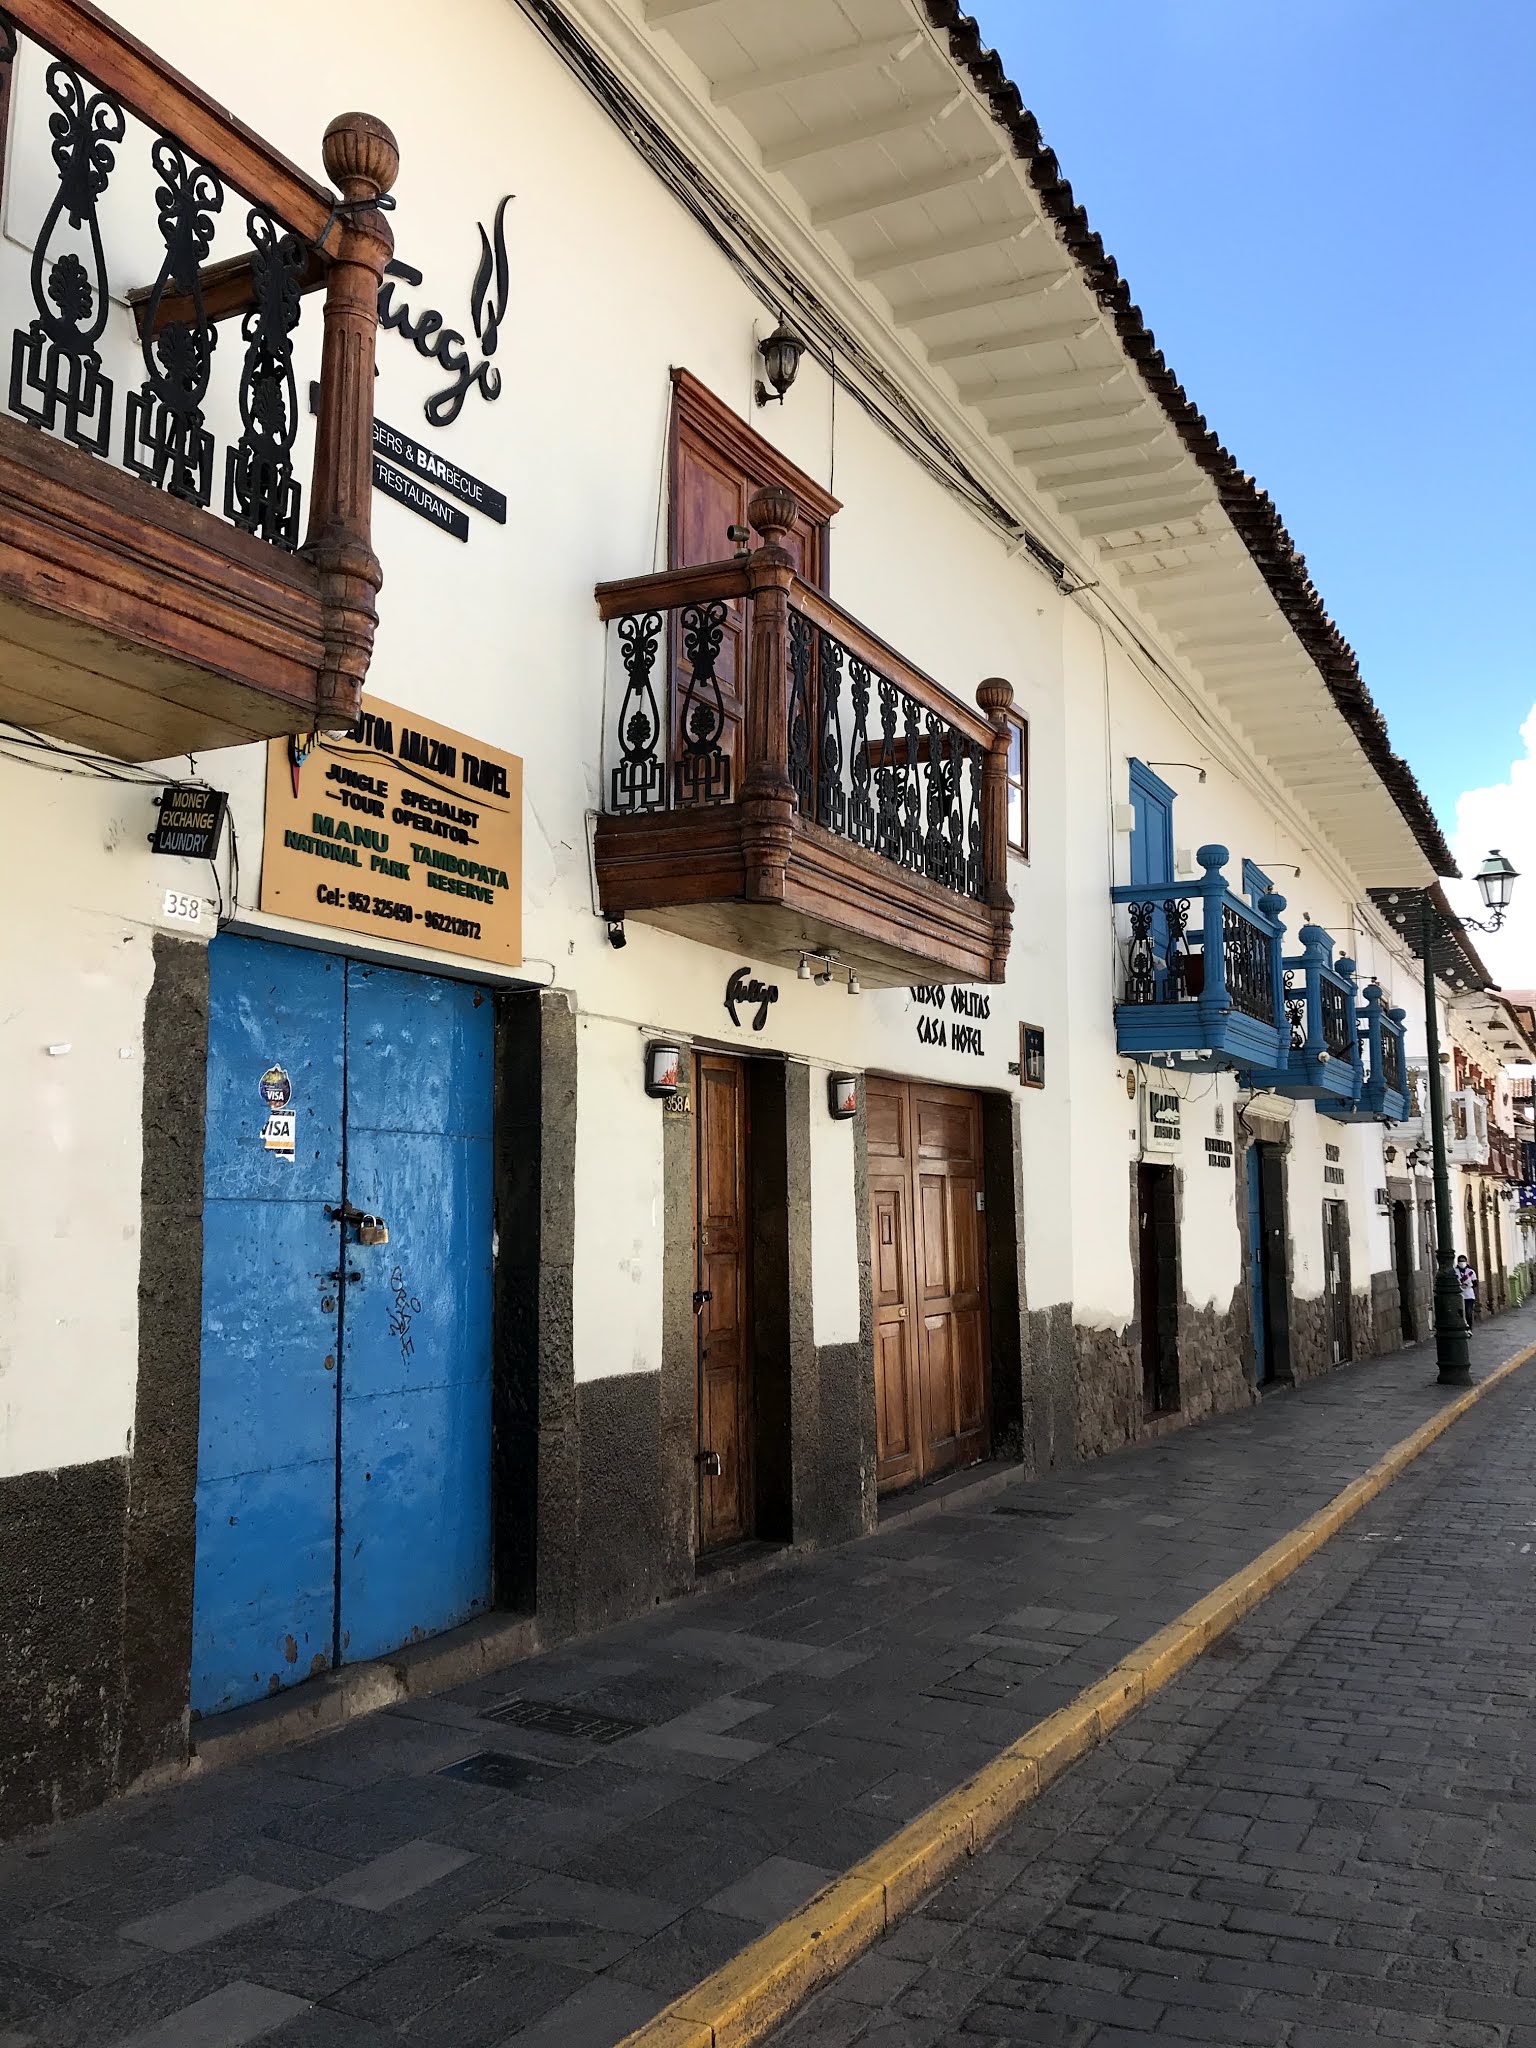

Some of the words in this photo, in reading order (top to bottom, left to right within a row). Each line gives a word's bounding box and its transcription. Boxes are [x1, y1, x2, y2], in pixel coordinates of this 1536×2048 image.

[377, 258, 501, 427] uego
[379, 464, 454, 524] RESTAURANT
[405, 445, 414, 462] &
[417, 449, 483, 503] BARBECUE
[399, 728, 457, 778] AMAZON
[462, 752, 511, 799] TRAVEL
[172, 792, 209, 808] MONEY
[326, 764, 388, 798] JUNGLE
[401, 788, 479, 828] SPECIALIST
[161, 811, 214, 829] EXCHANGE
[160, 831, 208, 852] LAUNDRY
[312, 813, 389, 852] MANU
[410, 843, 509, 889] TAMBOPATA
[284, 830, 362, 867] NATIONAL
[371, 855, 411, 881] PARK
[427, 871, 494, 905] RESERVE
[167, 894, 199, 919] 358
[317, 884, 345, 908] Cel:
[348, 892, 370, 914] 952
[951, 986, 990, 1019] OBLITAS
[917, 1015, 947, 1047] CASA
[952, 1023, 985, 1056] HOTEL
[267, 1090, 284, 1101] VISA
